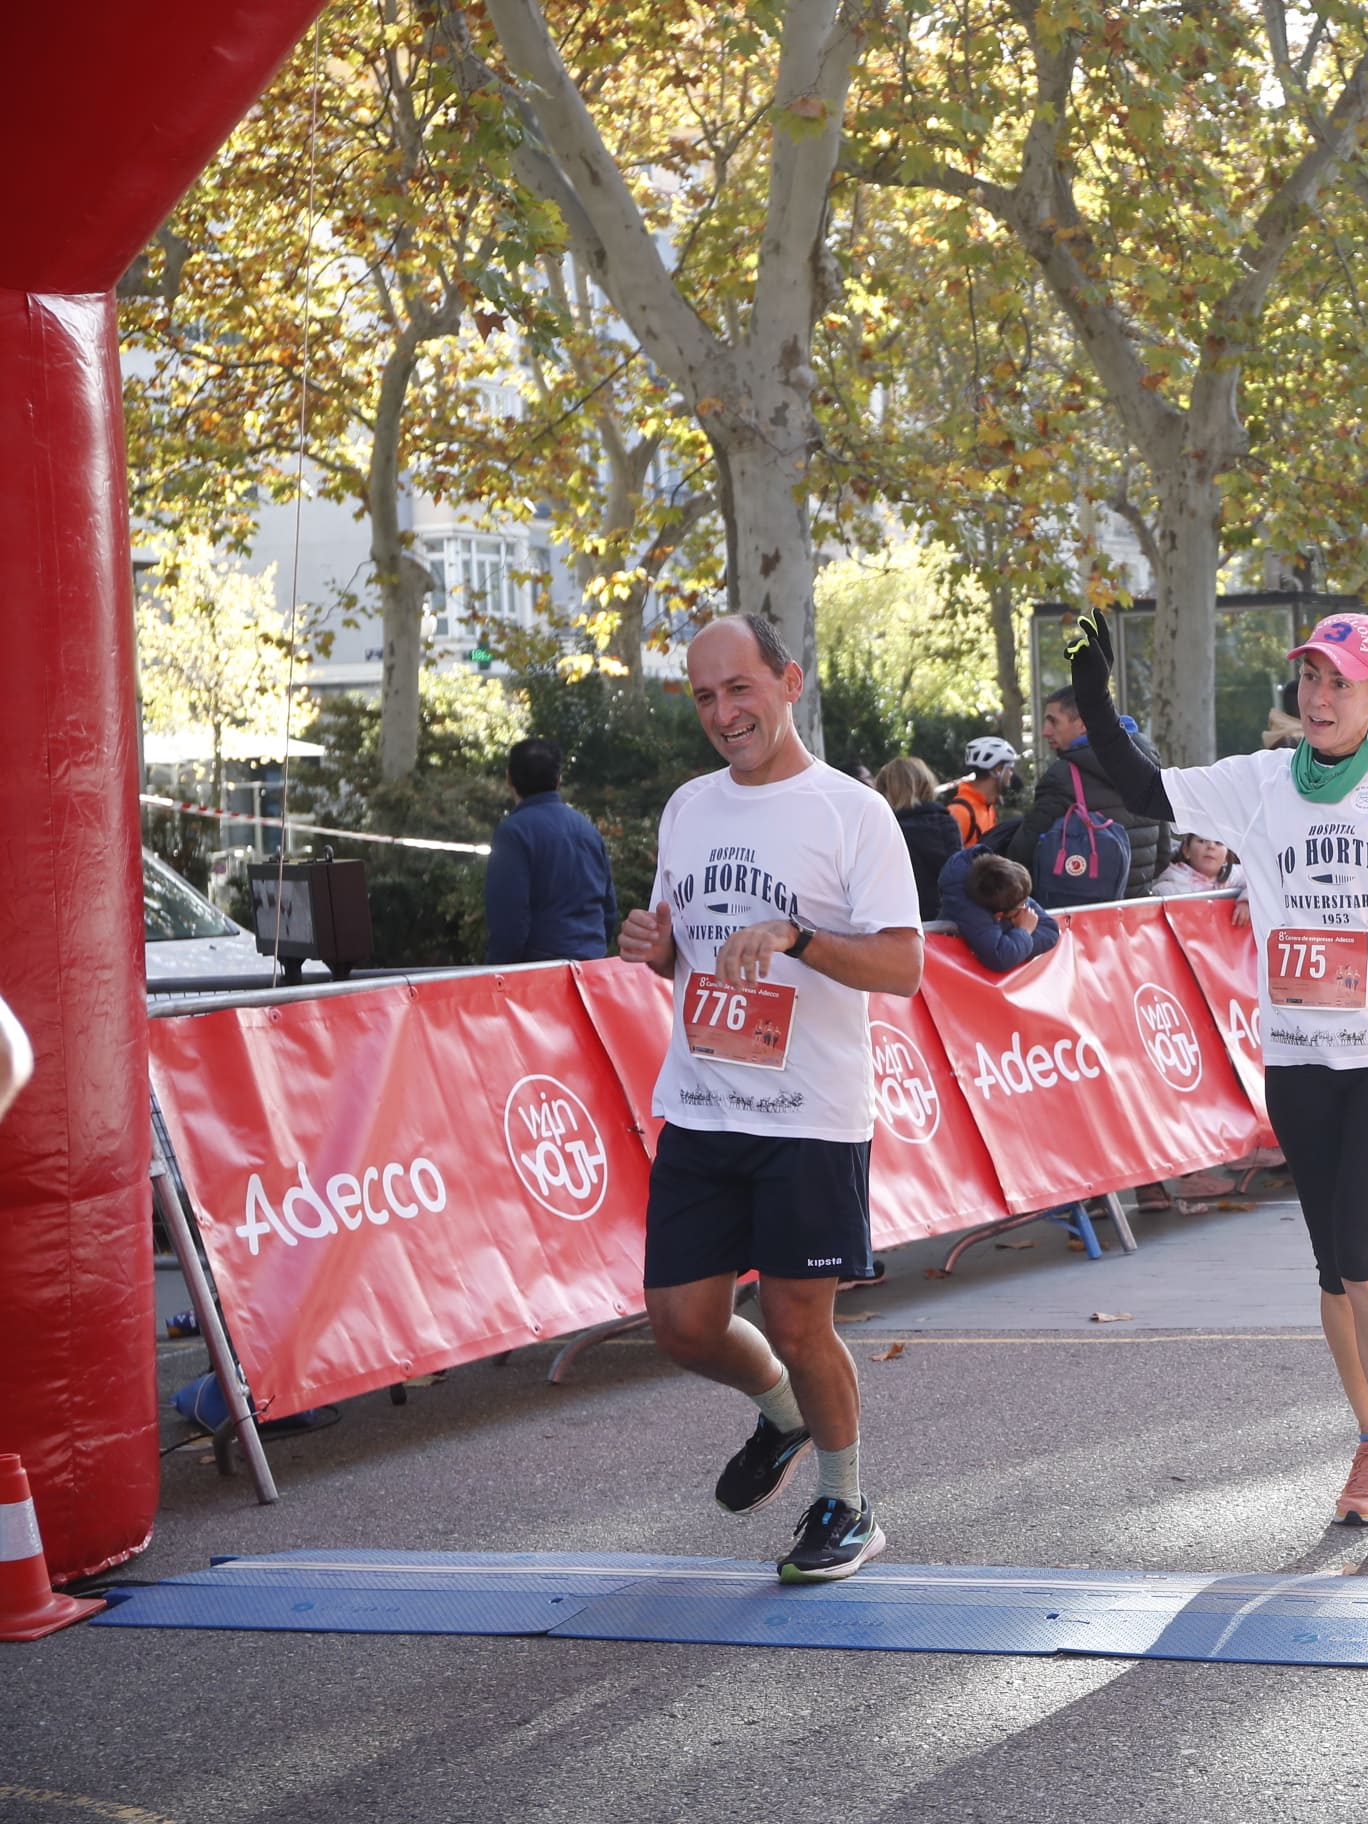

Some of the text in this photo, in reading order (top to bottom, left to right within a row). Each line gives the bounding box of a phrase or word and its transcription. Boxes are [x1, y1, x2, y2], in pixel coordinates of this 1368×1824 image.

[1324, 622, 1353, 643] 3
[1308, 823, 1356, 836] HOSPITAL
[709, 847, 756, 863] HOSPITAL
[704, 863, 799, 918] HORTEGA
[1321, 913, 1350, 925] 1953
[1278, 944, 1327, 979] 775
[692, 989, 747, 1031] 776
[235, 1160, 448, 1255] Adecco
[807, 1257, 842, 1268] kipsta
